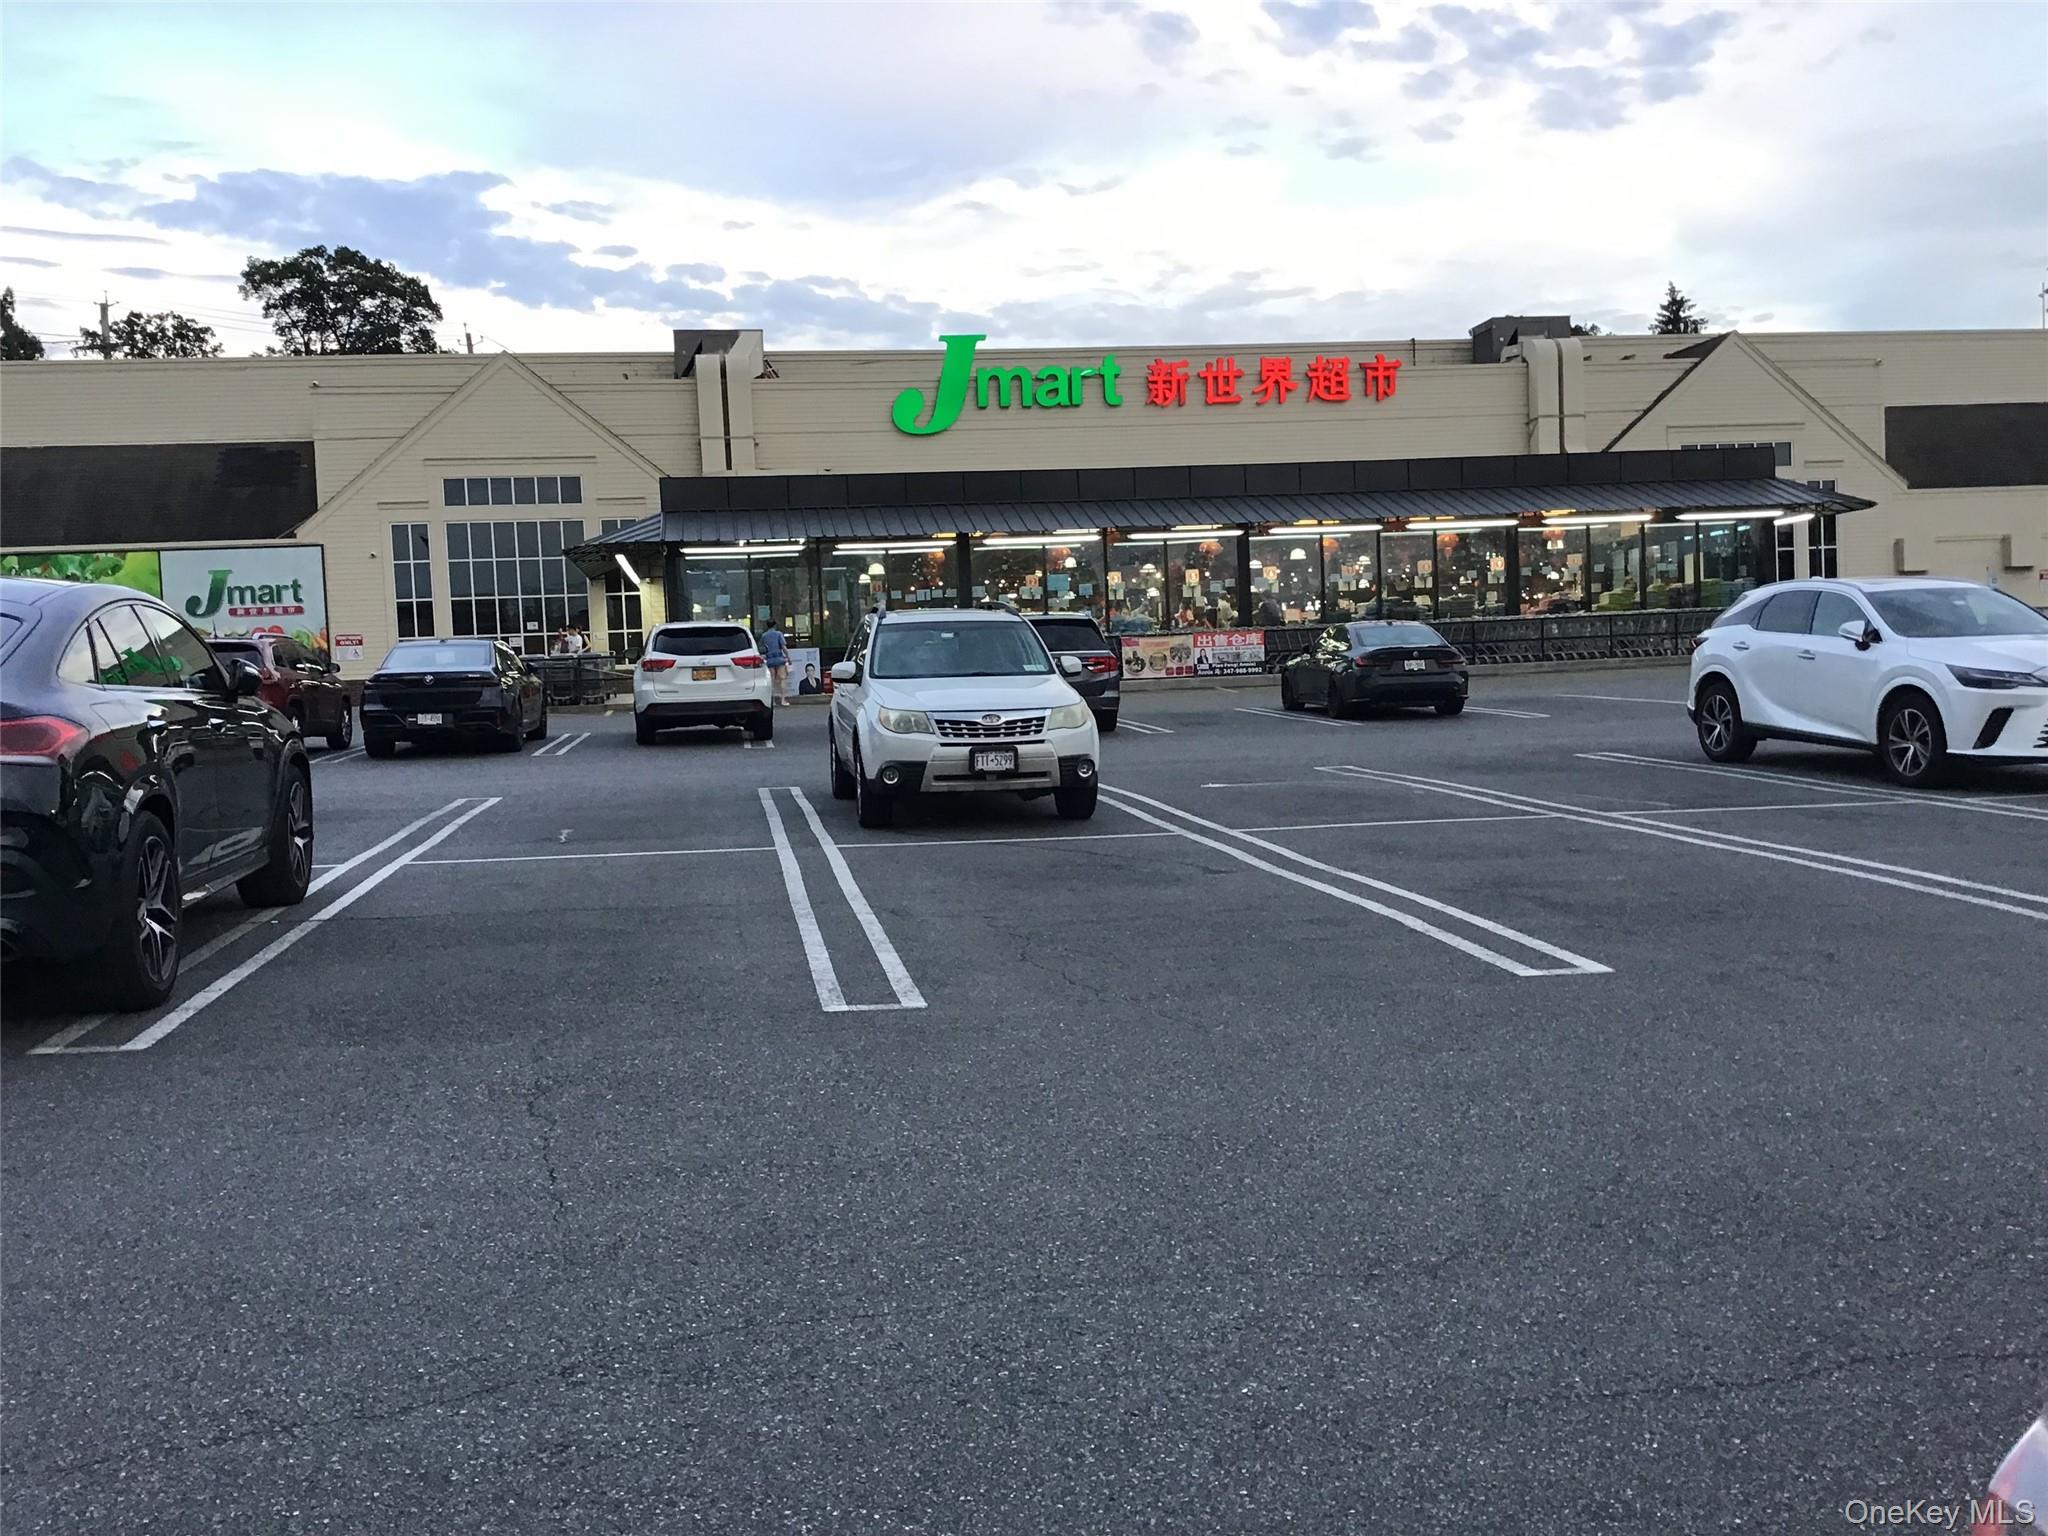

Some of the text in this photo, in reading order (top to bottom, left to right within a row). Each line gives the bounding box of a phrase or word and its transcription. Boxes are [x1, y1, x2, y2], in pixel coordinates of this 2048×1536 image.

[892, 334, 1123, 435] Jmart
[1146, 353, 1402, 408] 新世界超市
[185, 569, 304, 618] Jmart
